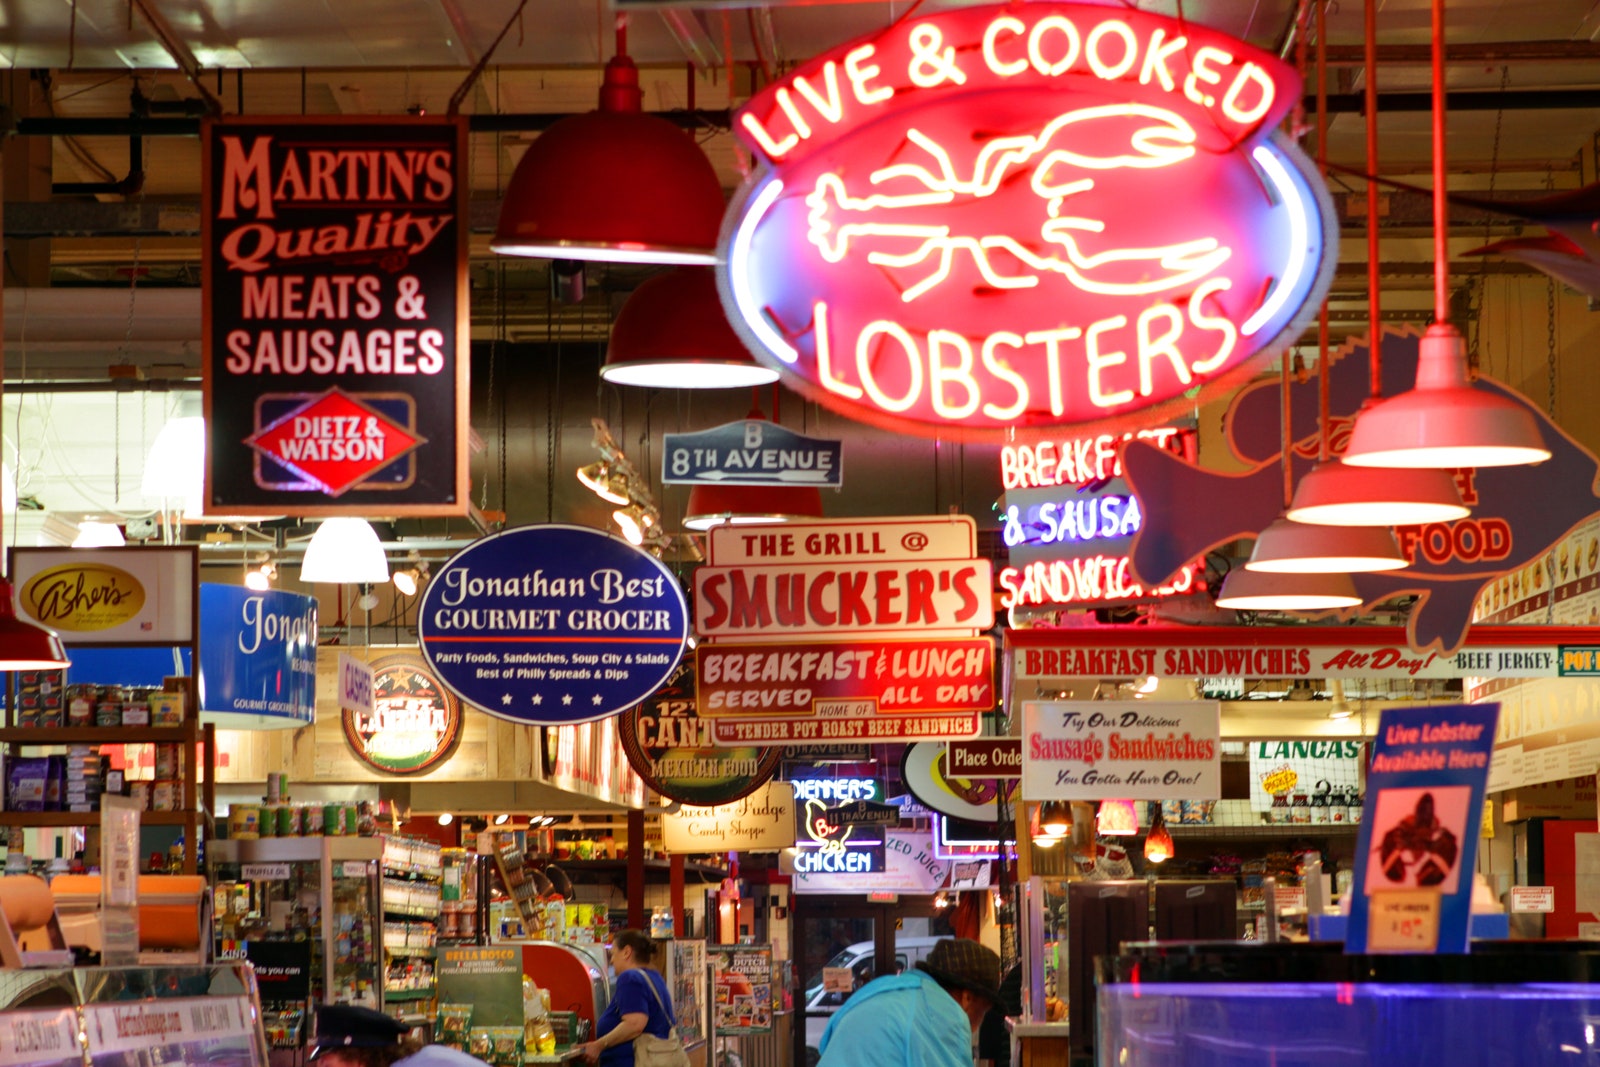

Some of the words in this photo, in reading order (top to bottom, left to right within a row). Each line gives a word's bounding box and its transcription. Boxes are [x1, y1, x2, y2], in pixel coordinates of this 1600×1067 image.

[741, 43, 895, 158] LIVE
[907, 22, 967, 88] &
[982, 14, 1276, 125] COOKED
[217, 134, 454, 219] MARTIN'S
[220, 211, 454, 272] Quality
[242, 275, 381, 320] MEATS
[395, 275, 427, 320] &
[226, 329, 445, 375] SAUSAGES
[811, 276, 1238, 420] LOBSTERS
[294, 415, 362, 439] DIETZ
[364, 417, 385, 439] &
[743, 423, 763, 449] B
[279, 438, 385, 462] WATSON
[672, 448, 717, 476] 8TH
[723, 449, 833, 470] AVENUE
[1003, 504, 1025, 546] &
[741, 532, 796, 557] THE
[804, 531, 886, 556] GRILL
[900, 531, 929, 552] @
[1396, 519, 1510, 563] FOOD
[441, 567, 587, 607] Jonathan
[590, 568, 665, 604] Best
[701, 565, 979, 630] SMUCKER'S
[434, 608, 561, 630] GOURMET
[567, 609, 671, 631] GROCER
[436, 652, 463, 664] Party
[465, 652, 500, 665] Foods,
[503, 653, 569, 665] Sandwiches,
[572, 653, 599, 665] Soup
[601, 653, 622, 665] City
[624, 653, 633, 665] &
[635, 653, 670, 665] Salads
[703, 650, 874, 684] BREAKFAST
[892, 647, 987, 680] LUNCH
[1025, 648, 1157, 676] BREAKFAST
[1164, 648, 1312, 676] SANDWICHES
[1322, 648, 1369, 670] All
[1370, 648, 1438, 675] Day!
[1456, 651, 1494, 670] BEEF
[1497, 651, 1551, 672] JERKEY
[1563, 651, 1592, 671] POT
[476, 668, 499, 679] Best
[502, 668, 514, 679] of
[516, 668, 547, 681] Philly
[549, 668, 591, 681] Spreads
[604, 668, 629, 680] Dips
[707, 688, 812, 708] SERVED
[879, 685, 924, 705] ALL
[935, 683, 989, 703] DAY
[819, 704, 850, 718] HOME
[855, 703, 871, 716] OF
[1062, 711, 1085, 732] Try
[1087, 711, 1117, 728] Our
[1120, 711, 1181, 728] Delicious
[718, 724, 735, 737] THE
[736, 721, 791, 740] TENDER
[793, 720, 820, 738] POT
[821, 719, 866, 737] ROAST
[867, 718, 903, 735] BEEF
[904, 716, 974, 735] SANDWICH
[1385, 723, 1420, 746] Live
[1421, 721, 1485, 743] Lobster
[955, 748, 987, 766] Place
[1030, 732, 1103, 765] Sausage
[1108, 732, 1215, 761] Sandwiches
[650, 757, 720, 779] MEXICAN
[722, 757, 758, 777] FOOD
[1372, 750, 1446, 773] Available
[1448, 750, 1487, 769] Here
[1055, 769, 1079, 786] You
[1081, 769, 1122, 786] Gotta
[1125, 769, 1160, 786] Have
[1162, 769, 1202, 786] One!
[852, 809, 897, 821] AVENUE
[793, 851, 872, 872] CHICKEN
[913, 850, 945, 882] JUICE
[221, 949, 248, 959] KIND
[734, 958, 766, 966] DUTCH
[268, 967, 284, 976] you
[730, 965, 770, 974] CORNER
